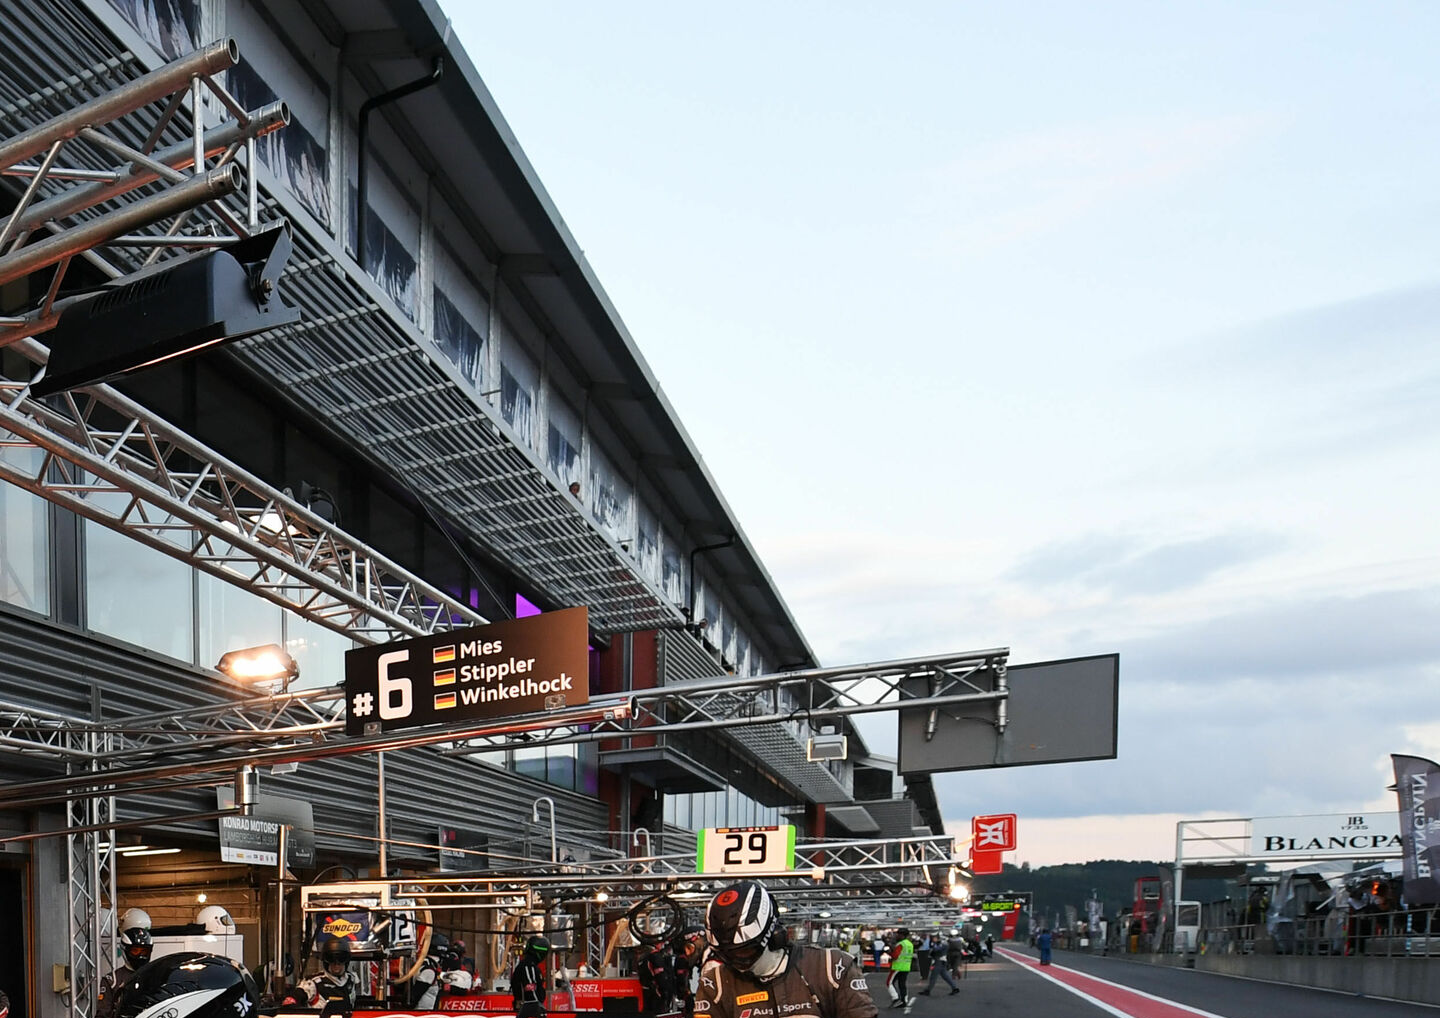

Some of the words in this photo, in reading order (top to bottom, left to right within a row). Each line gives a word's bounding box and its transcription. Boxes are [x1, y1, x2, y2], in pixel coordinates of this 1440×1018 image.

[460, 639, 502, 659] Mies
[460, 657, 535, 682] Stippler
[353, 649, 412, 720] #6
[461, 673, 572, 705] Winkelhock
[222, 816, 250, 830] KONRAD
[250, 819, 279, 834] MOTORSP
[723, 832, 767, 865] 29
[1264, 834, 1404, 851] BLANCPA
[323, 924, 361, 933] SUNOCO
[443, 1000, 488, 1011] KESSEL
[782, 1002, 812, 1013] Sport
